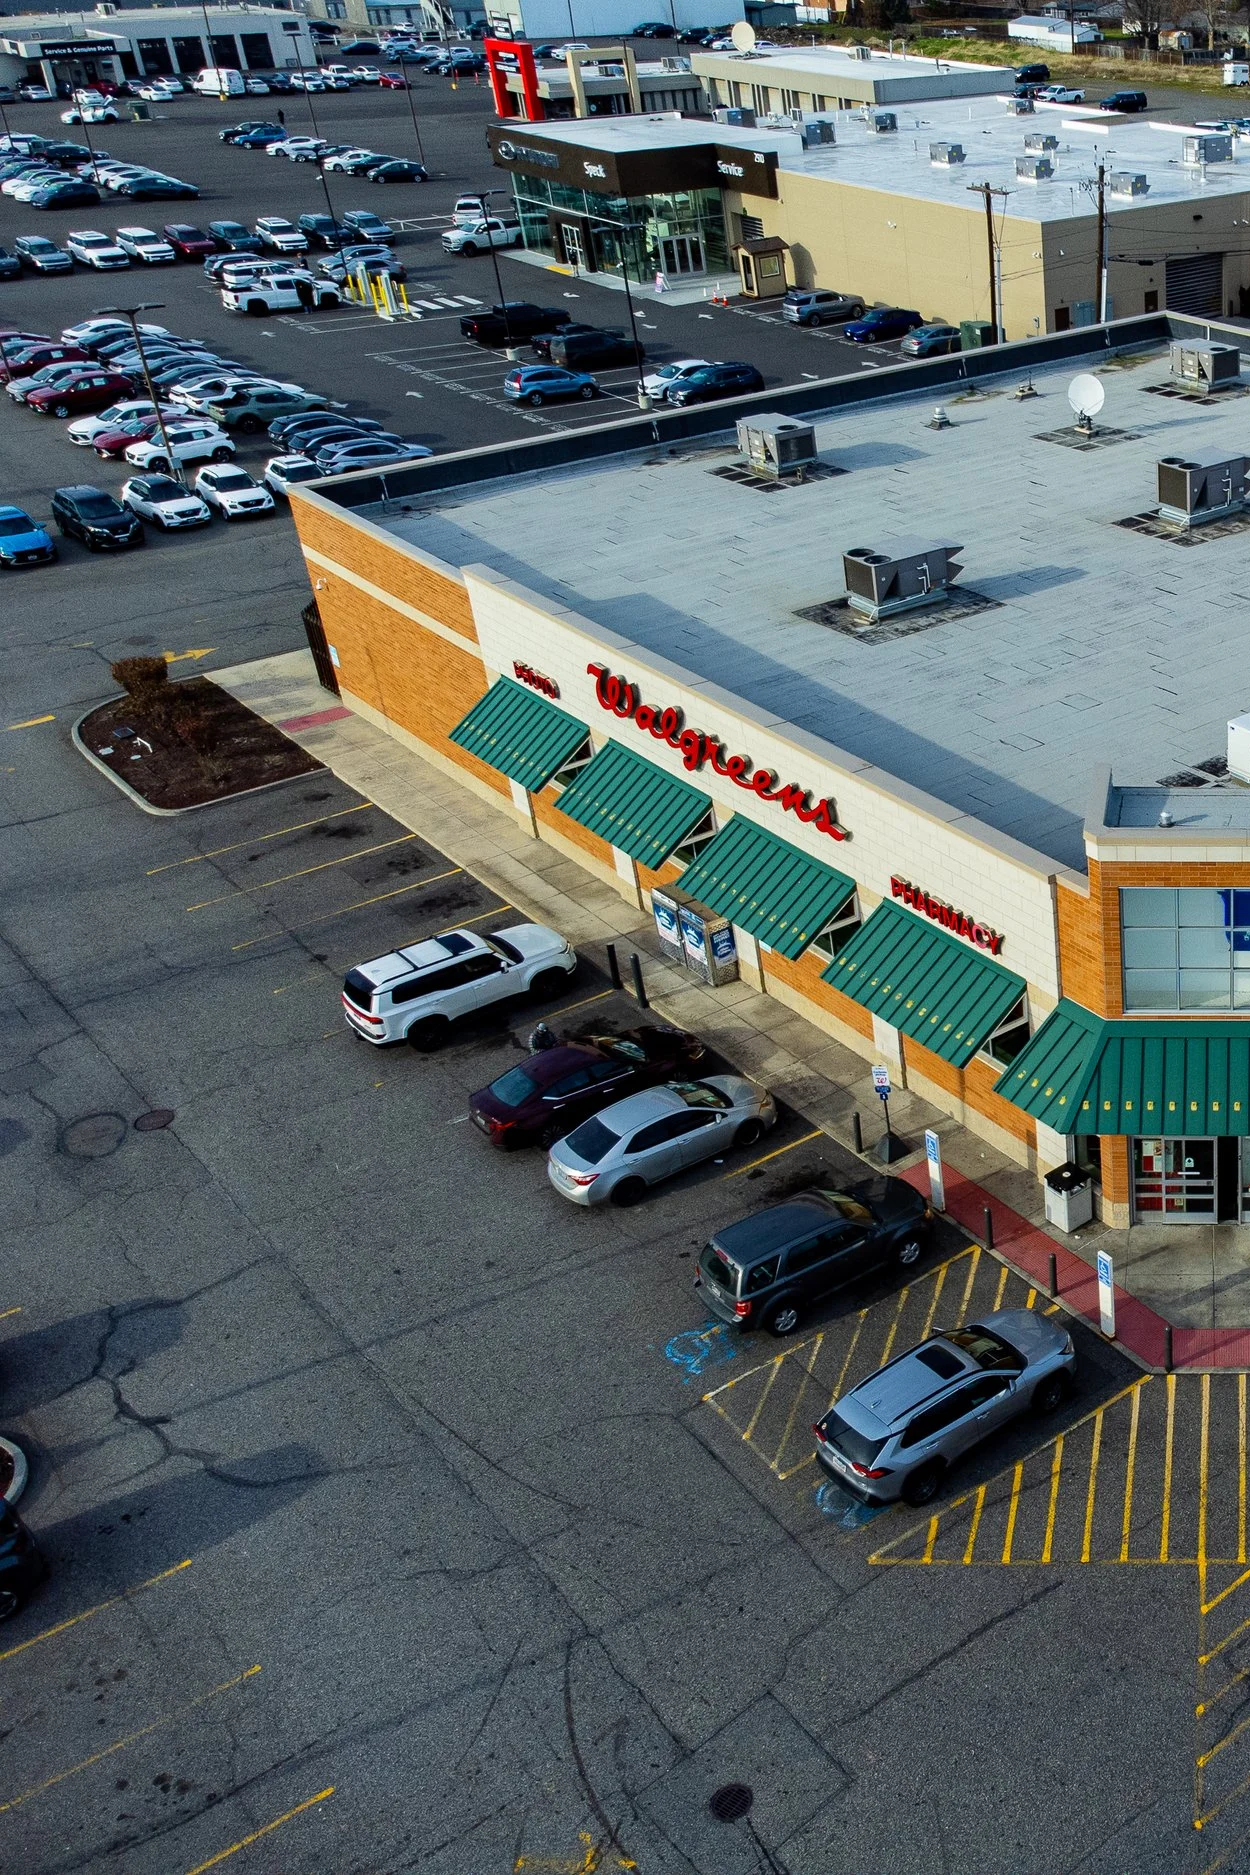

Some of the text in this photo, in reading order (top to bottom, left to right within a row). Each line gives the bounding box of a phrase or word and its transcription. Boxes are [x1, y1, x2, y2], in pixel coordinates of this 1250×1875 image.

[44, 47, 67, 55] Service
[73, 46, 97, 54] Genuine
[716, 160, 744, 177] Service
[513, 660, 558, 699] PHOTO
[587, 662, 851, 842] Walgreens
[890, 874, 1004, 956] PHARMACY
